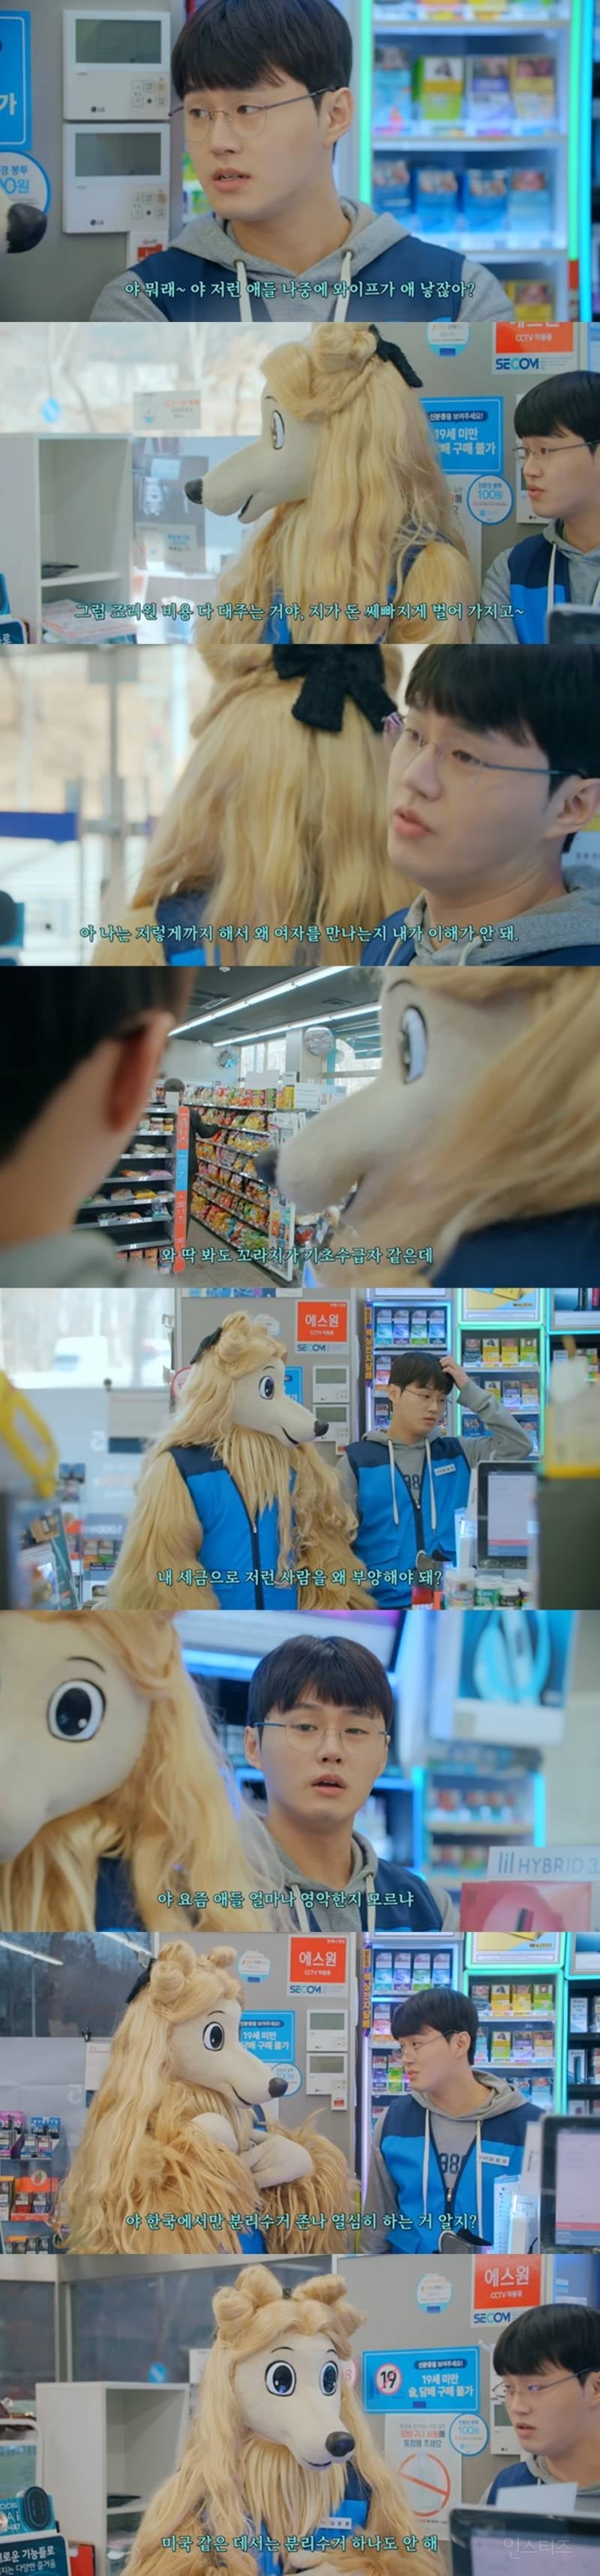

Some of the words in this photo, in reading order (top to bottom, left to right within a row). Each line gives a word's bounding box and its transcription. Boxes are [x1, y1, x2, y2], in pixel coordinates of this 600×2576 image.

[515, 333, 533, 342] CCTV
[495, 357, 539, 371] SECOM
[434, 427, 456, 441] 19세
[458, 427, 478, 441] 미만
[452, 442, 473, 455] 구매
[305, 1314, 338, 1327] 에스원
[297, 1344, 326, 1352] SECOM
[498, 1852, 514, 1874] lil
[518, 1857, 584, 1874] HYBRID
[298, 1951, 337, 1967] 에스원
[290, 1985, 322, 1994] SECOM
[484, 2265, 530, 2287] 에스원
[490, 2291, 506, 2299] CCTV
[473, 2312, 512, 2324] SECOM
[380, 2370, 398, 2390] 19
[22, 2545, 56, 2560] 기능들로
[0, 2566, 14, 2576] 지는
